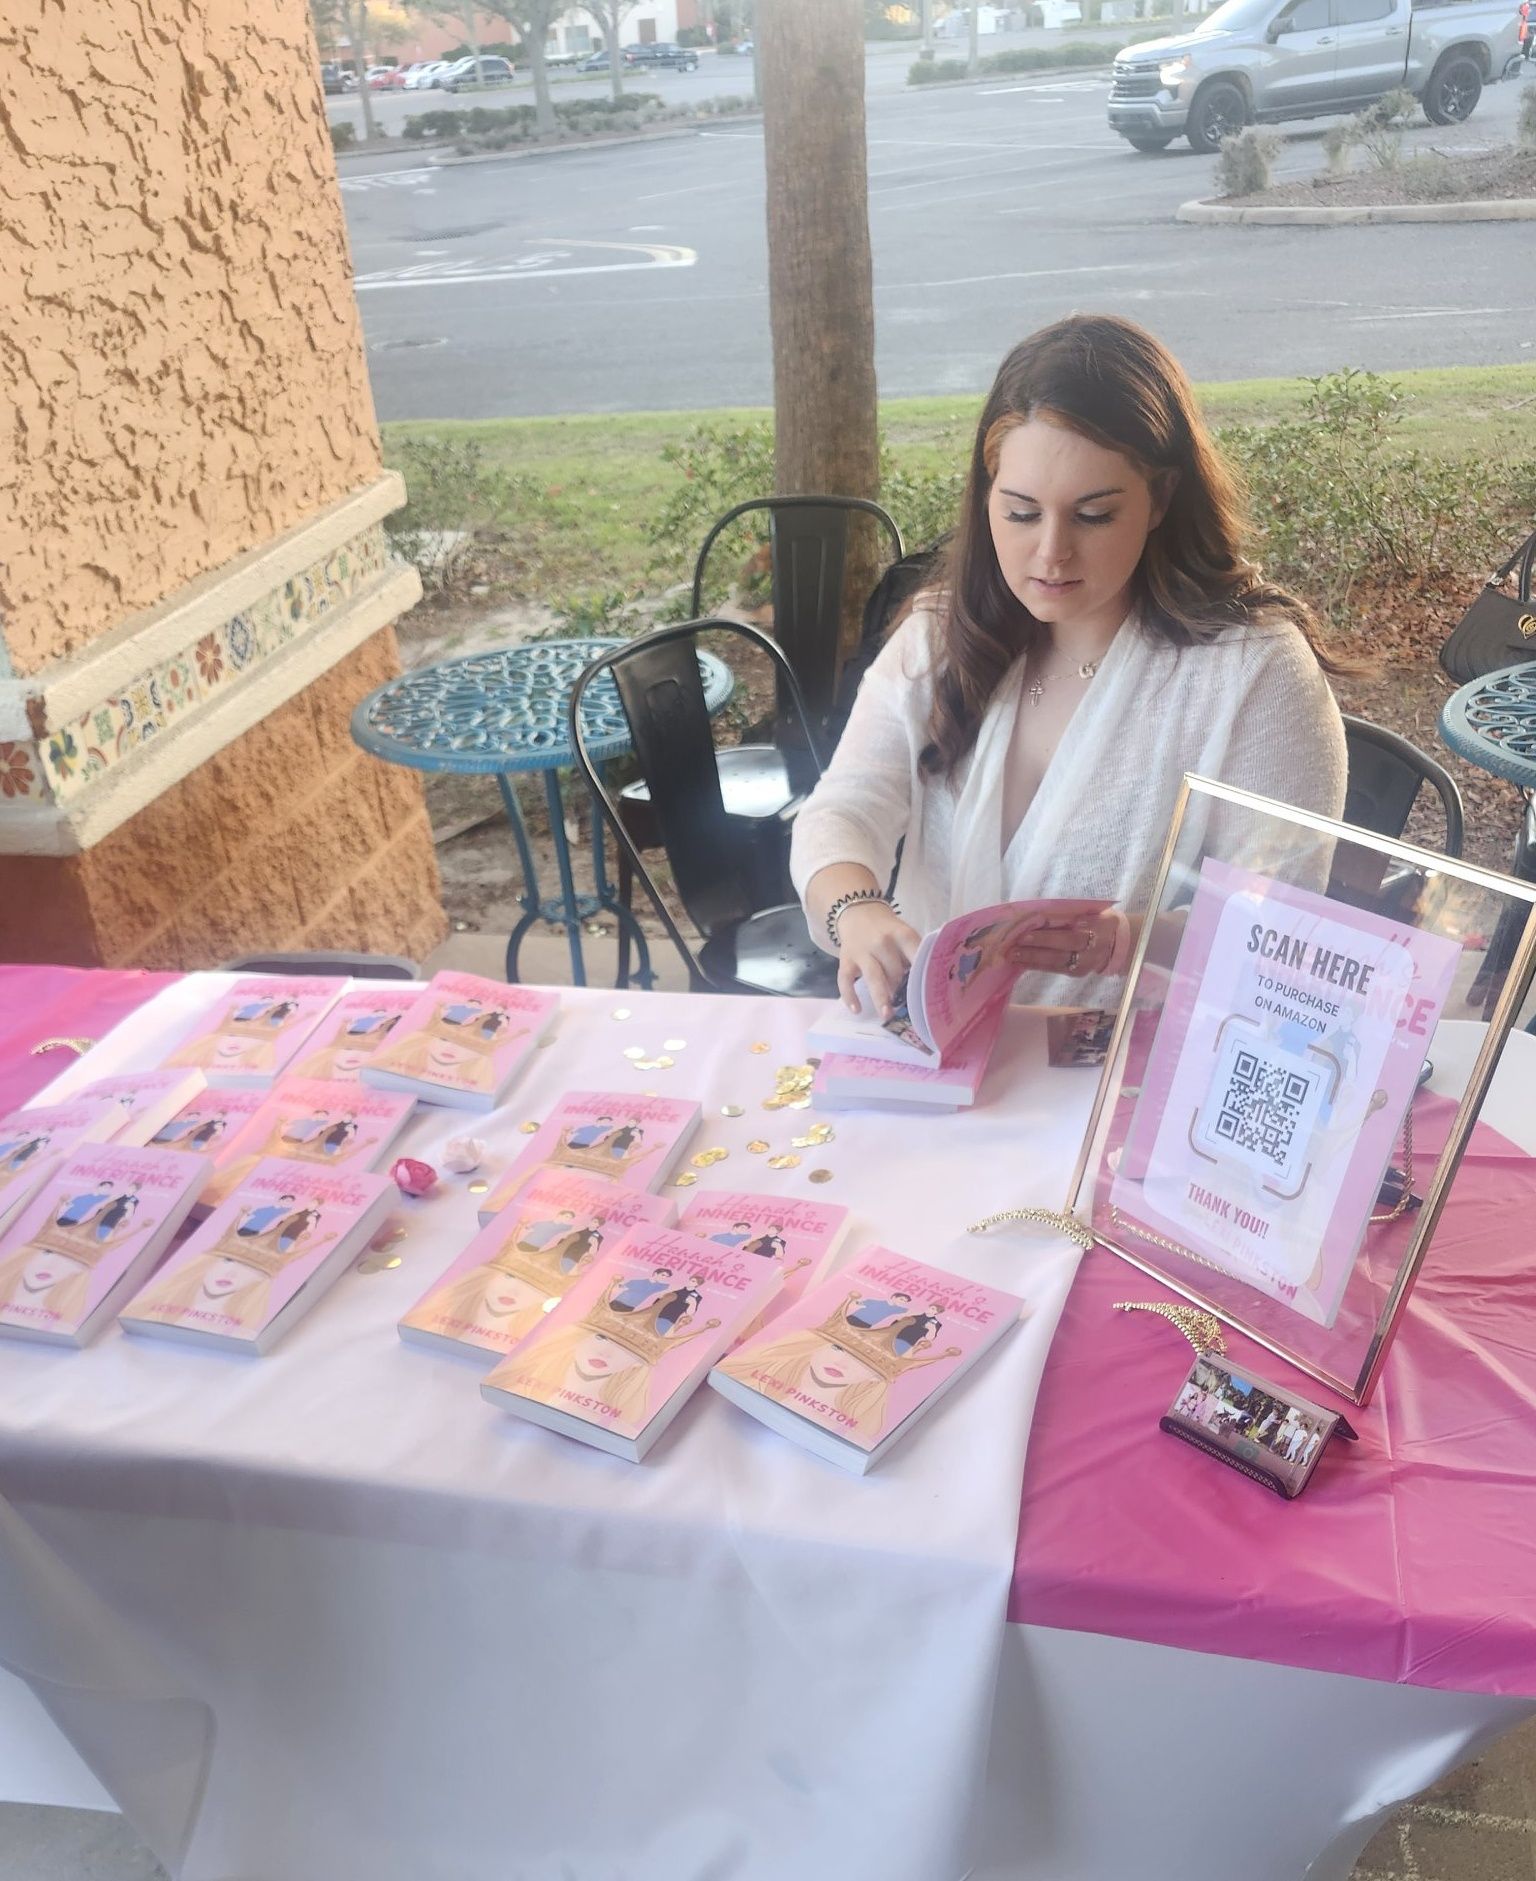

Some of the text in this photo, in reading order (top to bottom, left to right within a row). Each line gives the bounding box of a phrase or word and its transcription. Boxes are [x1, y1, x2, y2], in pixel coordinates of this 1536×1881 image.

[1246, 924, 1308, 970] SCAN
[1310, 947, 1375, 996] HERE
[1254, 995, 1327, 1034] ON AMAZON
[1257, 974, 1273, 990] TO
[1274, 981, 1340, 1017] PURCHASE
[563, 1105, 681, 1122] INHERITANCE
[696, 1208, 828, 1234] INHERITANCE
[1187, 1183, 1232, 1219] THANK
[1233, 1206, 1270, 1239] YOU!!
[622, 1244, 752, 1291] INHERITANCE
[858, 1264, 995, 1324] INHERITANCE
[463, 1323, 520, 1346] PINKSTO
[516, 1372, 622, 1418] LEXI PINKSTON
[751, 1369, 859, 1428] LEXI PINKSTON
